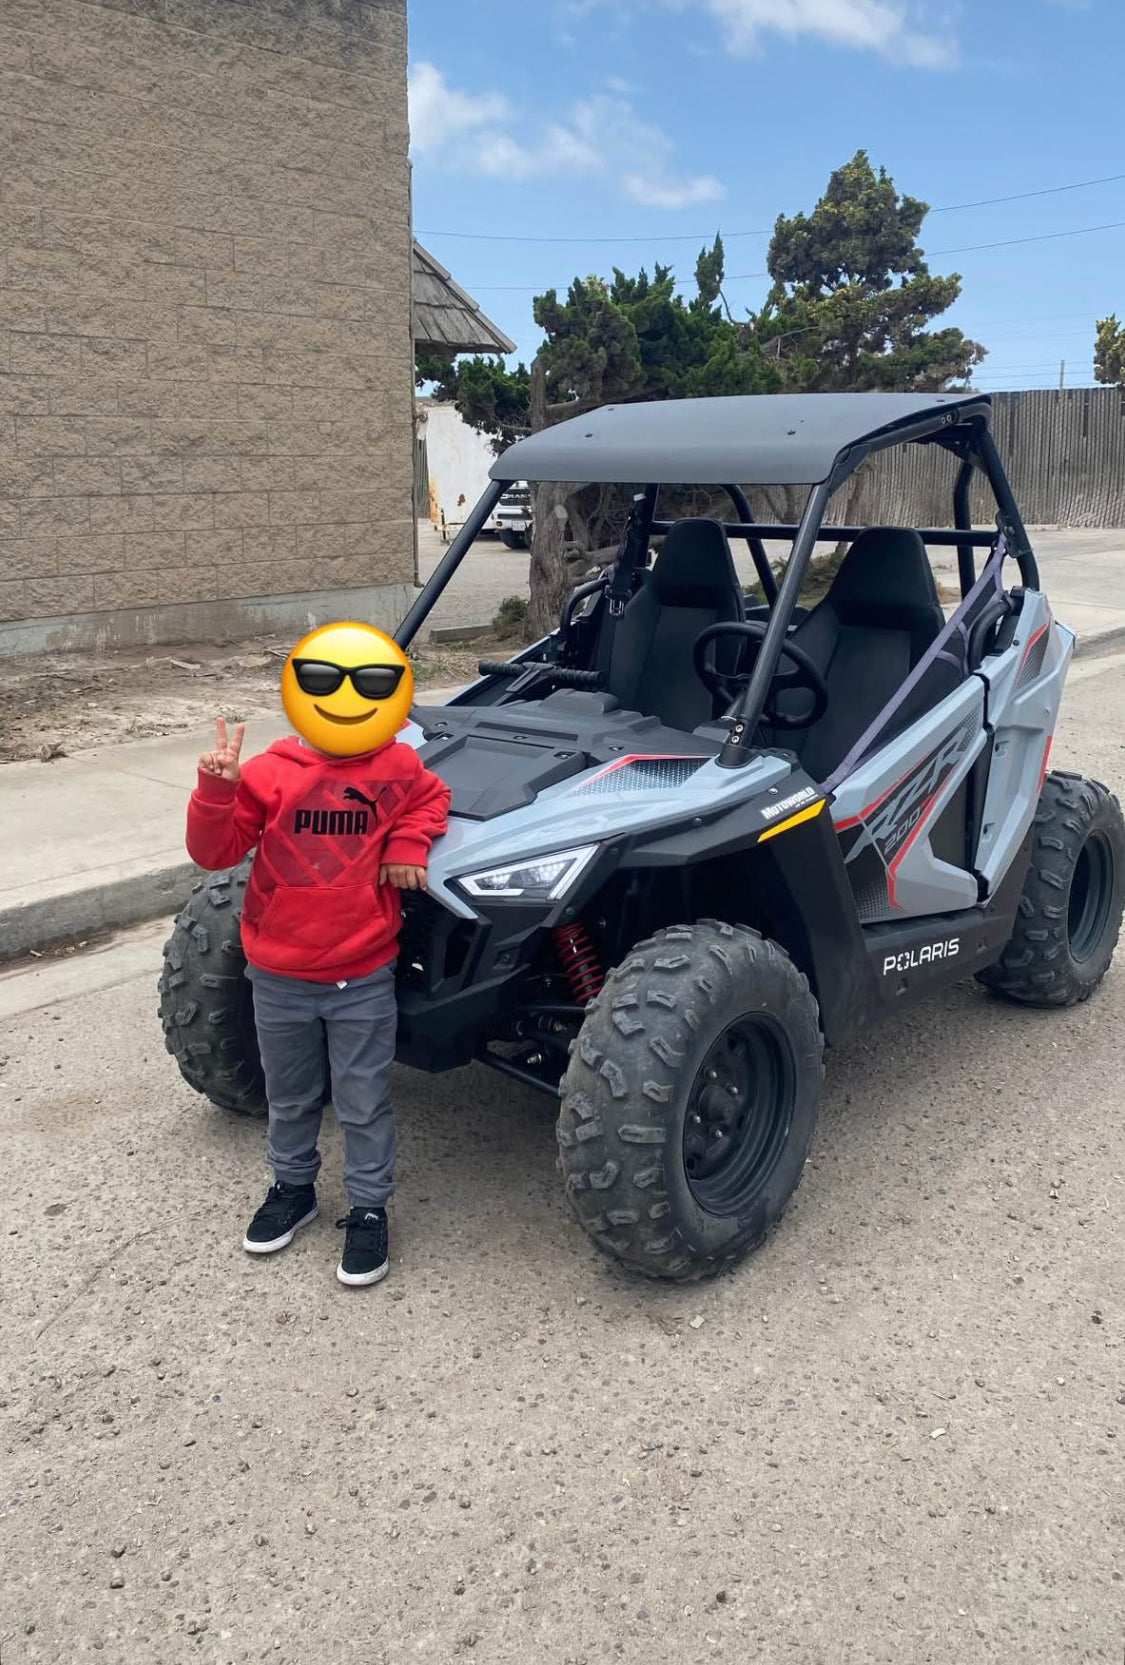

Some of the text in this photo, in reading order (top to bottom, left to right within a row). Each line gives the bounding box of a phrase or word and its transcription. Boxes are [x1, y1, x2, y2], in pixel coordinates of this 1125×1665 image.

[761, 786, 815, 820] MOTOWORLD
[845, 727, 969, 864] RZR
[294, 809, 368, 835] PUMA
[884, 808, 921, 855] 200
[883, 938, 959, 976] POLARIS
